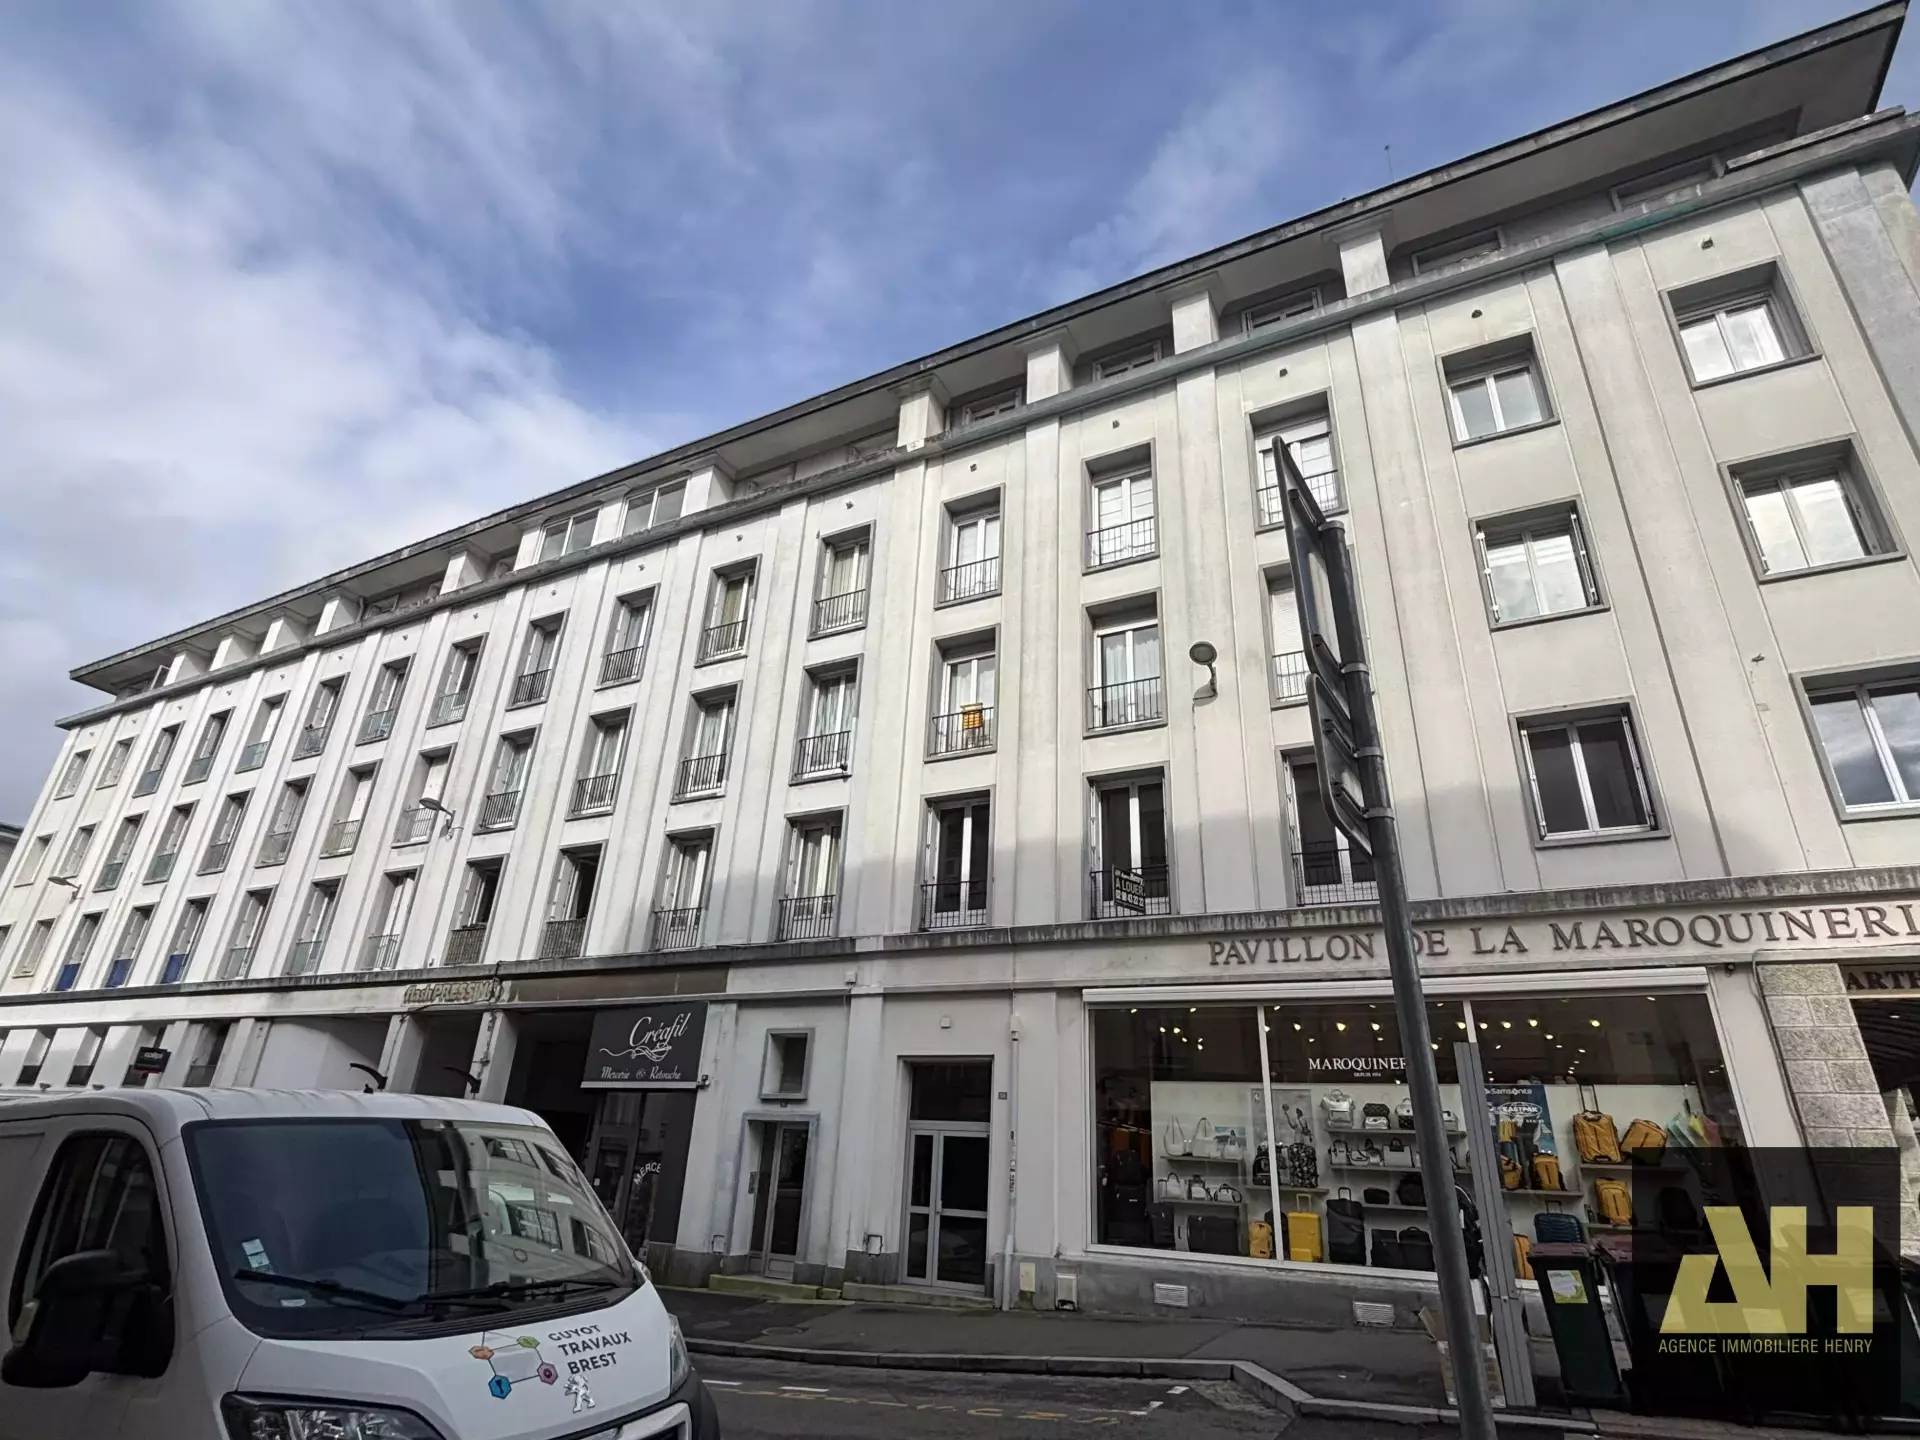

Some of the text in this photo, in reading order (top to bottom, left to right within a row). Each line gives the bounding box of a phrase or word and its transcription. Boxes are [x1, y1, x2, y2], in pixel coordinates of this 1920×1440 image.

[1209, 932, 1375, 965] PAVILLON
[1470, 925, 1528, 954] LA
[1548, 903, 1920, 950] MAROQUINERI
[629, 1012, 692, 1047] Créafil
[1490, 1087, 1533, 1096] Samsonite
[548, 1324, 601, 1342] GUYOT
[558, 1331, 633, 1356] TRAVAUX
[567, 1351, 617, 1375] BREST
